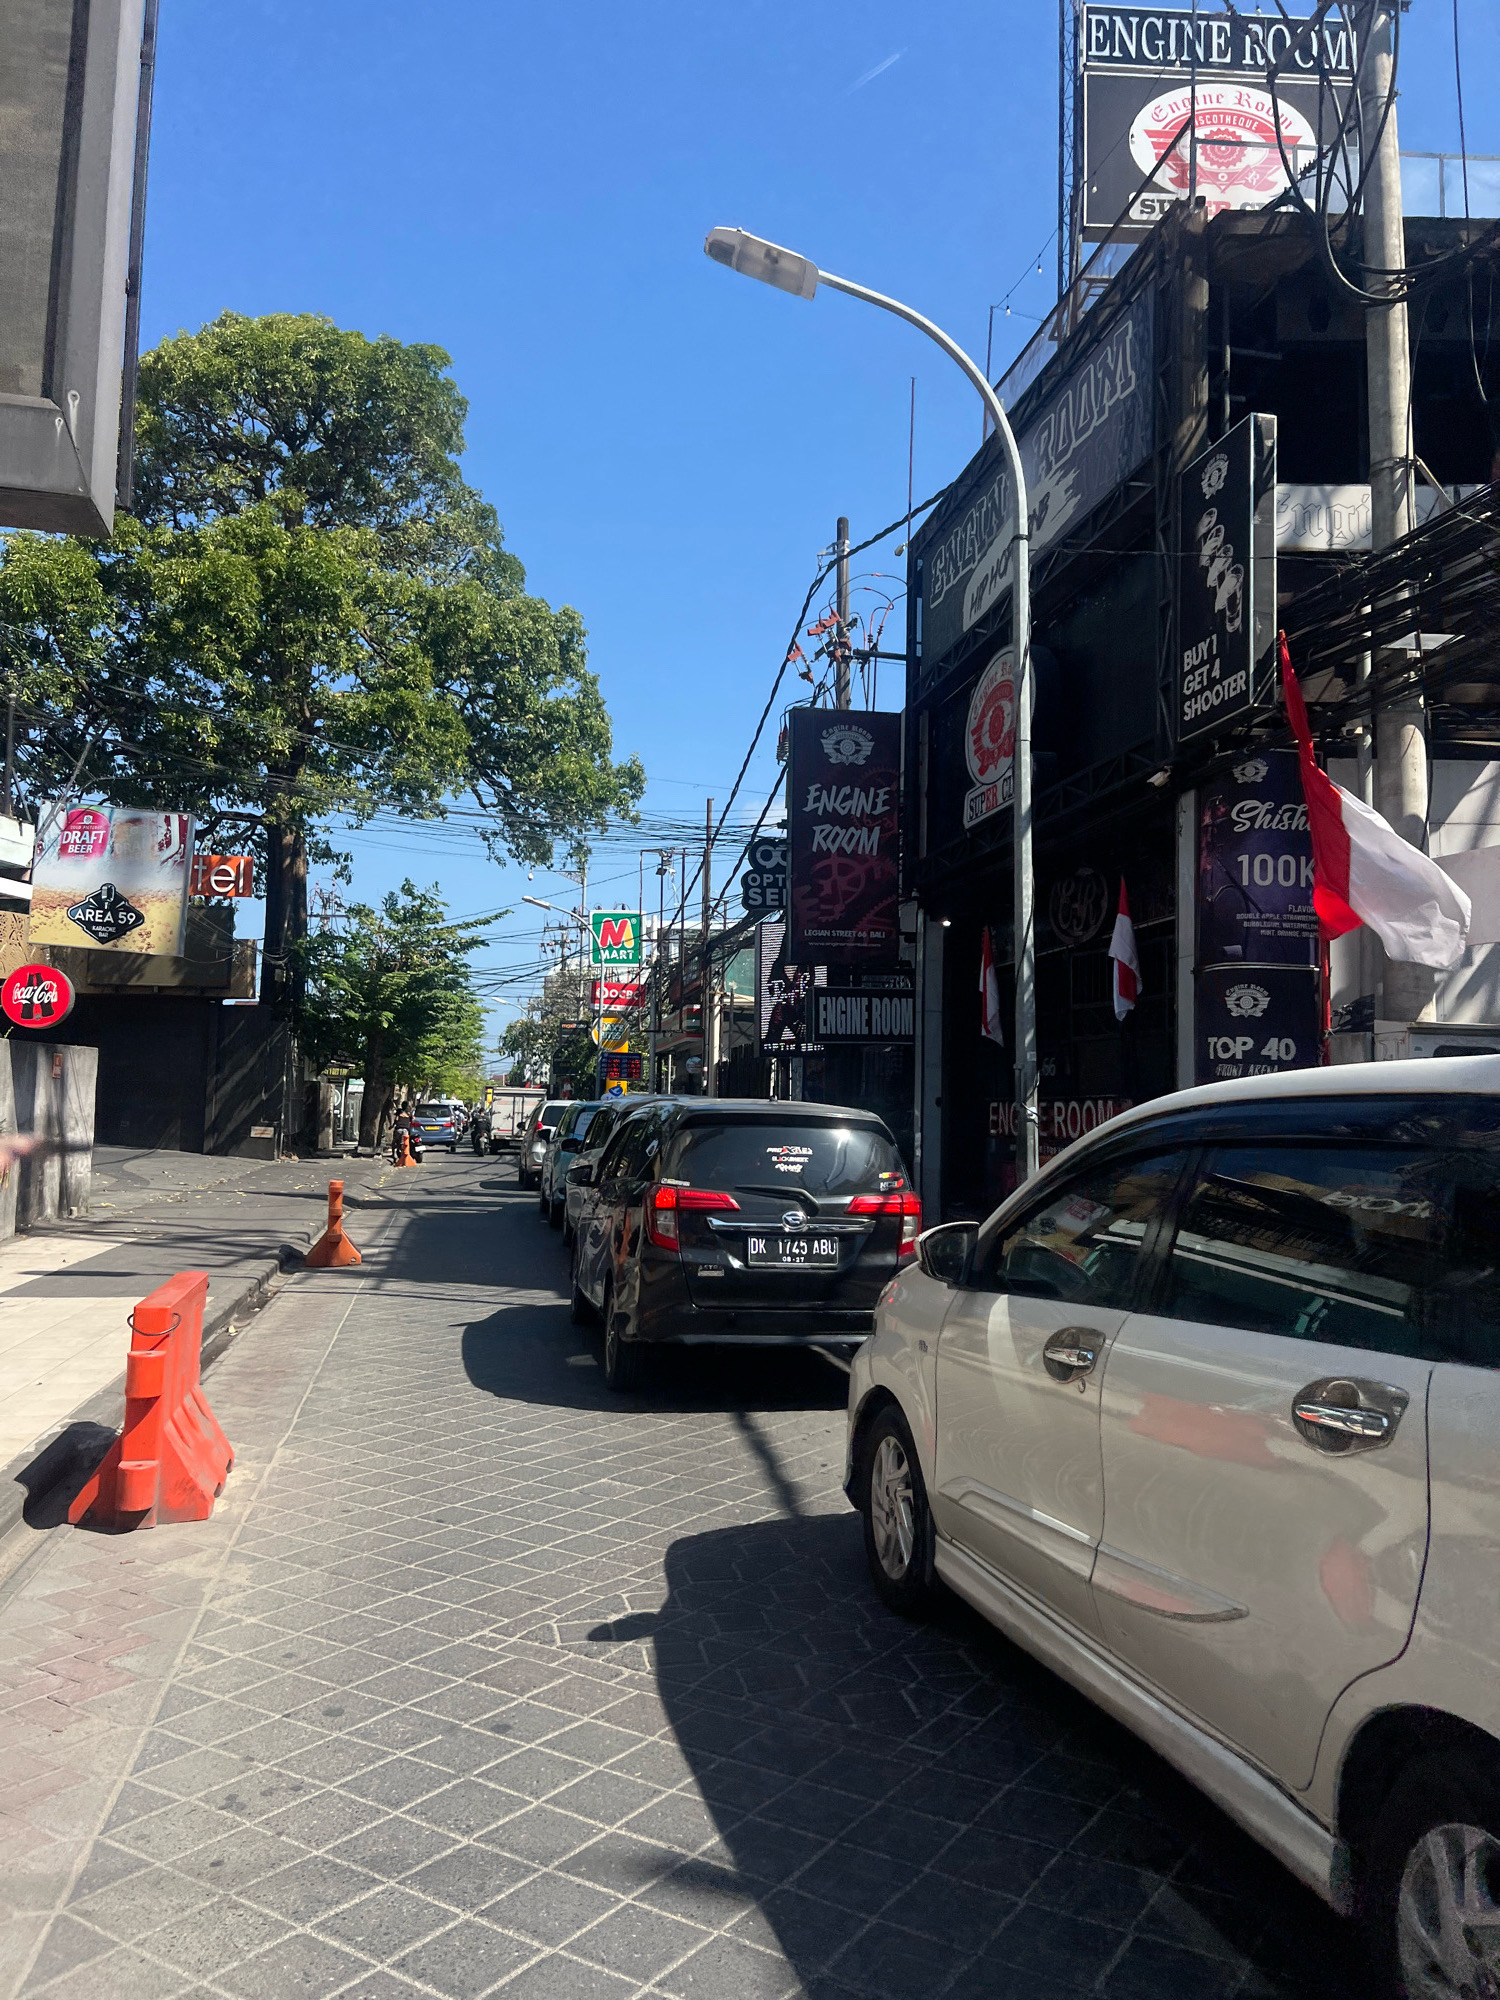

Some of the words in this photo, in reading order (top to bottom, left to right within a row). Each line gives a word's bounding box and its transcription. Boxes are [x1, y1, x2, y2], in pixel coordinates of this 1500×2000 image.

[1088, 14, 1232, 64] ENGINE
[1242, 22, 1359, 71] ROOM
[1151, 91, 1225, 123] Engine
[1233, 90, 1293, 130] Room
[1192, 113, 1259, 131] ISCOTHEQUE
[1139, 198, 1231, 217] SUER
[930, 472, 1013, 609] ENGIN
[1032, 319, 1136, 480] ROOM
[1183, 636, 1211, 673] BUY
[1211, 632, 1218, 656] 1
[1183, 663, 1210, 696] GET
[1211, 657, 1221, 680] 4
[1183, 669, 1247, 722] SHOOTER
[802, 783, 892, 818] ENGINE
[968, 784, 999, 820] SUPER
[1230, 799, 1313, 833] Shish
[62, 830, 107, 844] DRAFT
[68, 844, 93, 854] BEER
[811, 822, 881, 857] ROOM
[193, 857, 245, 894] tel
[747, 873, 786, 887] OPT
[1236, 853, 1315, 888] 100K
[747, 887, 787, 906] SEI
[74, 908, 115, 924] AREA
[118, 911, 137, 925] 59
[92, 925, 117, 933] KARAOKE
[804, 928, 830, 937] LEGIAN
[831, 929, 857, 938] STREET
[869, 930, 886, 939] BALI
[599, 949, 634, 961] MART
[609, 988, 641, 1001] OCBC
[818, 996, 869, 1036] ENGINE
[871, 996, 914, 1037] ROOM
[1207, 1036, 1255, 1060] TOP
[1260, 1036, 1297, 1061] 40
[1215, 1063, 1244, 1078] FRONT
[989, 1100, 1049, 1138] ENGE
[1053, 1099, 1114, 1140] ROOM
[750, 1237, 767, 1255] DK
[777, 1238, 808, 1256] 1745
[812, 1239, 837, 1256] ABU
